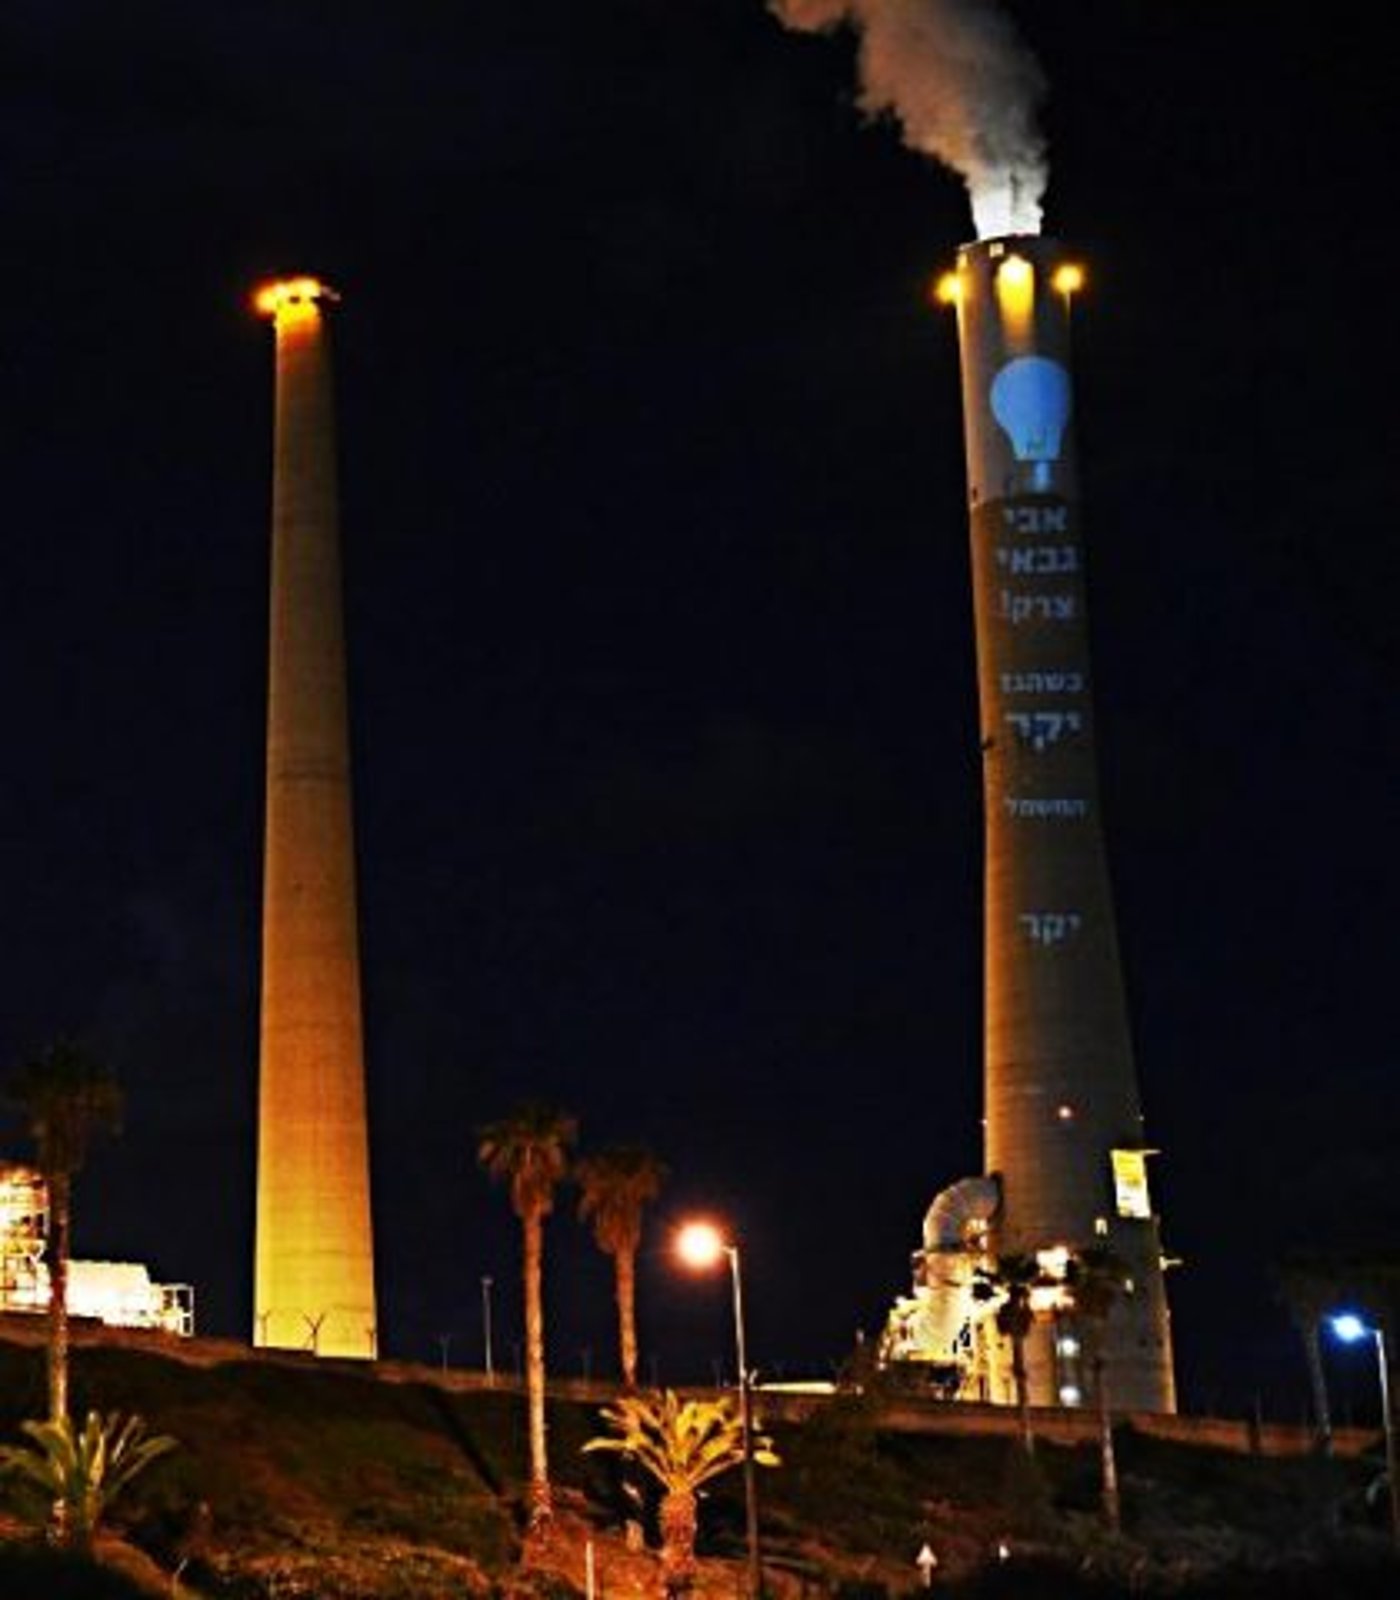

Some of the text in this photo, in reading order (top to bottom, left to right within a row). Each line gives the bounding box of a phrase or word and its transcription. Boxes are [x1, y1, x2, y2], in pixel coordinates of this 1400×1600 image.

[1002, 506, 1067, 533] אבי
[997, 546, 1077, 574] גבאי
[1004, 711, 1081, 751] יקר
[1018, 913, 1081, 946] יקר
